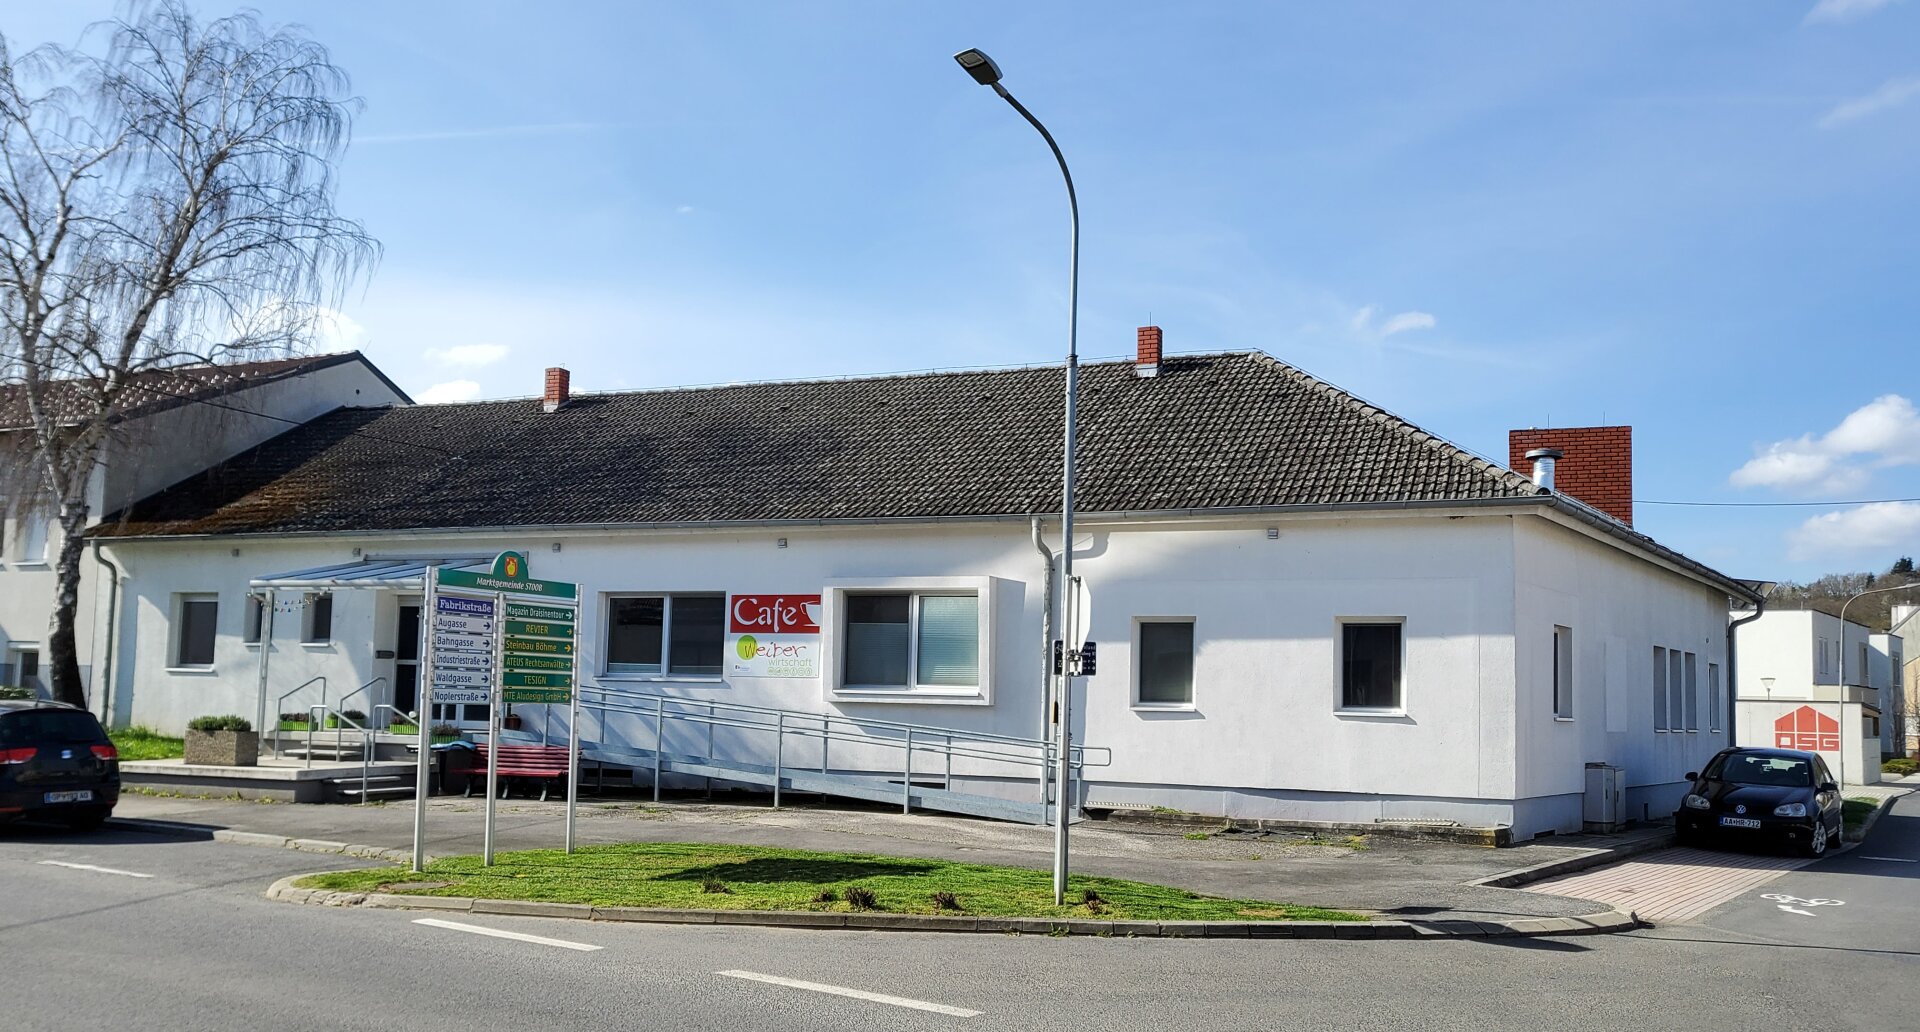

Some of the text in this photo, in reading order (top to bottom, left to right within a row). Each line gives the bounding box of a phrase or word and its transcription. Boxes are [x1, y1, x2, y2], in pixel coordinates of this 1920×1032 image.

[476, 577, 543, 592] Marktgemeinde STOOB
[439, 600, 492, 613] Fabrikstraße
[507, 606, 565, 619] Magazin Draisinentour
[734, 598, 797, 633] Cafe
[438, 618, 467, 630] Augasse
[525, 624, 549, 635] REVIER
[437, 636, 474, 648] Bahngasse
[506, 640, 557, 652] Steinbau Böhme
[744, 640, 807, 658] Weiber
[436, 654, 481, 666] Industriestraße
[506, 657, 565, 669] ATEUS Rechtsanwälte
[768, 658, 813, 667] wirtschaft
[435, 672, 472, 684] Waldgasse
[524, 675, 547, 685] TESIGN
[545, 692, 562, 701] GmbH
[1775, 733, 1840, 751] OSG
